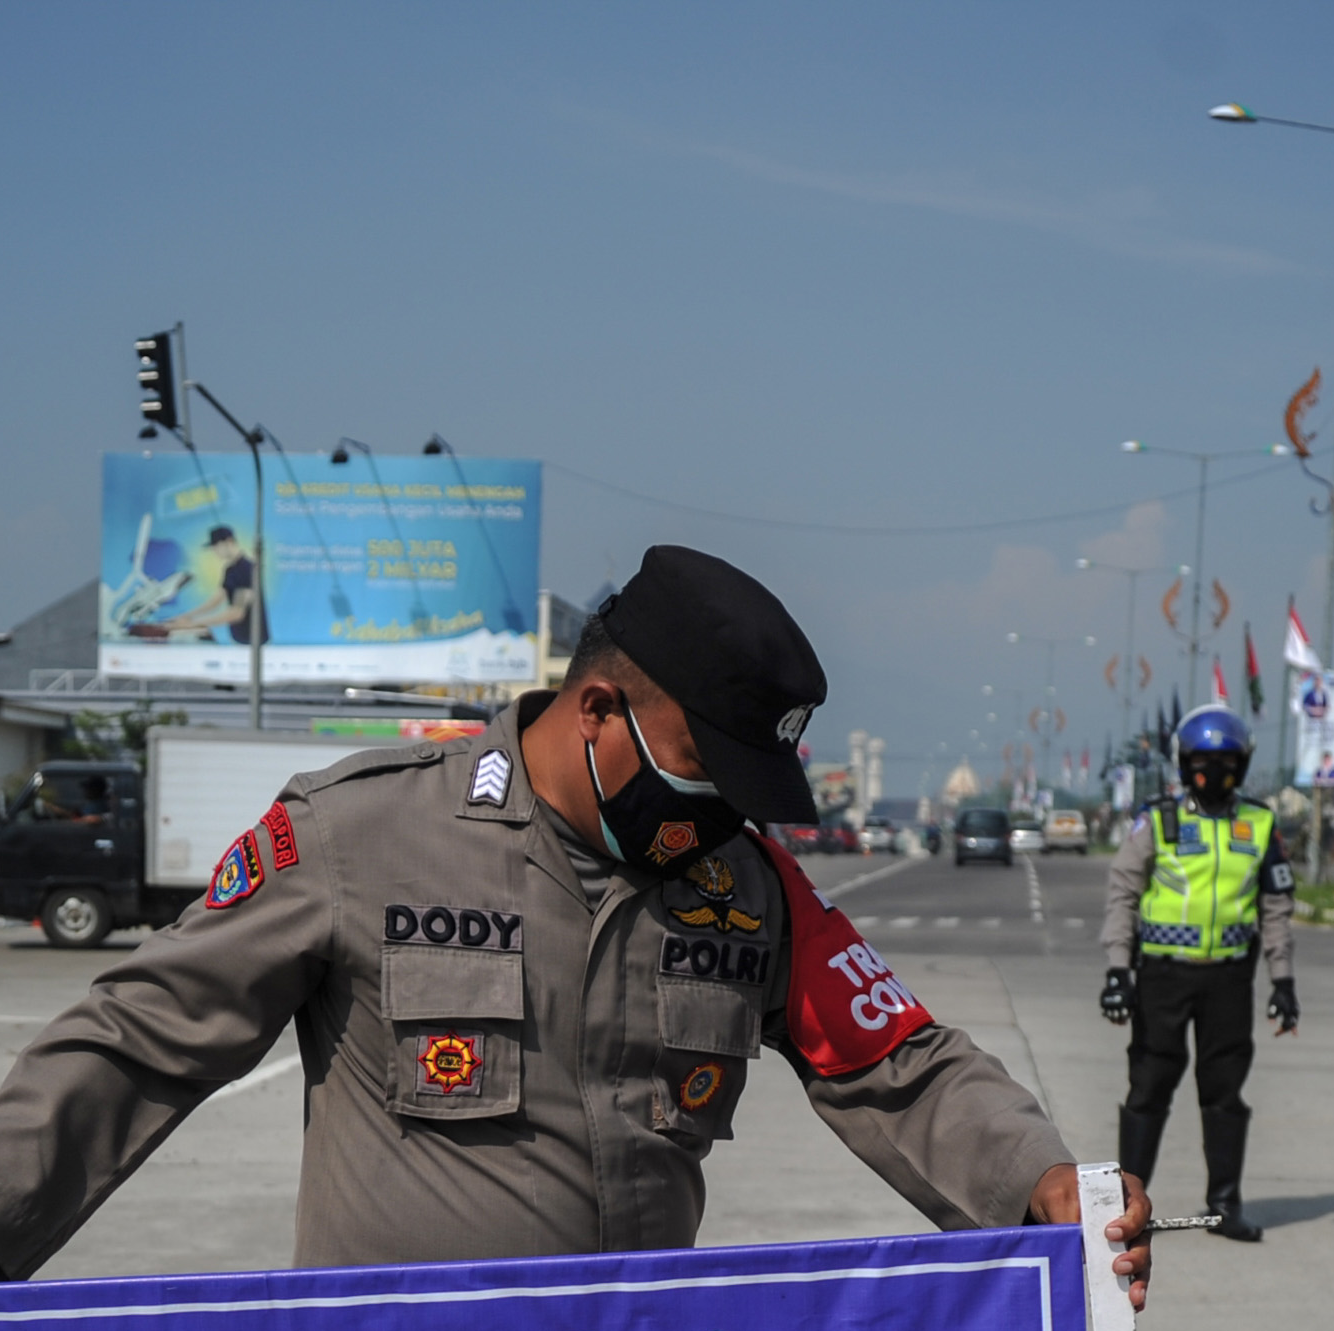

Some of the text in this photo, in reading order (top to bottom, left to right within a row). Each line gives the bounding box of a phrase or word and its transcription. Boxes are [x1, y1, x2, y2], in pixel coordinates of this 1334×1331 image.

[408, 540, 457, 559] JUTA
[383, 561, 457, 580] MILYAR
[384, 904, 522, 950] DODY
[661, 936, 771, 984] POLRI
